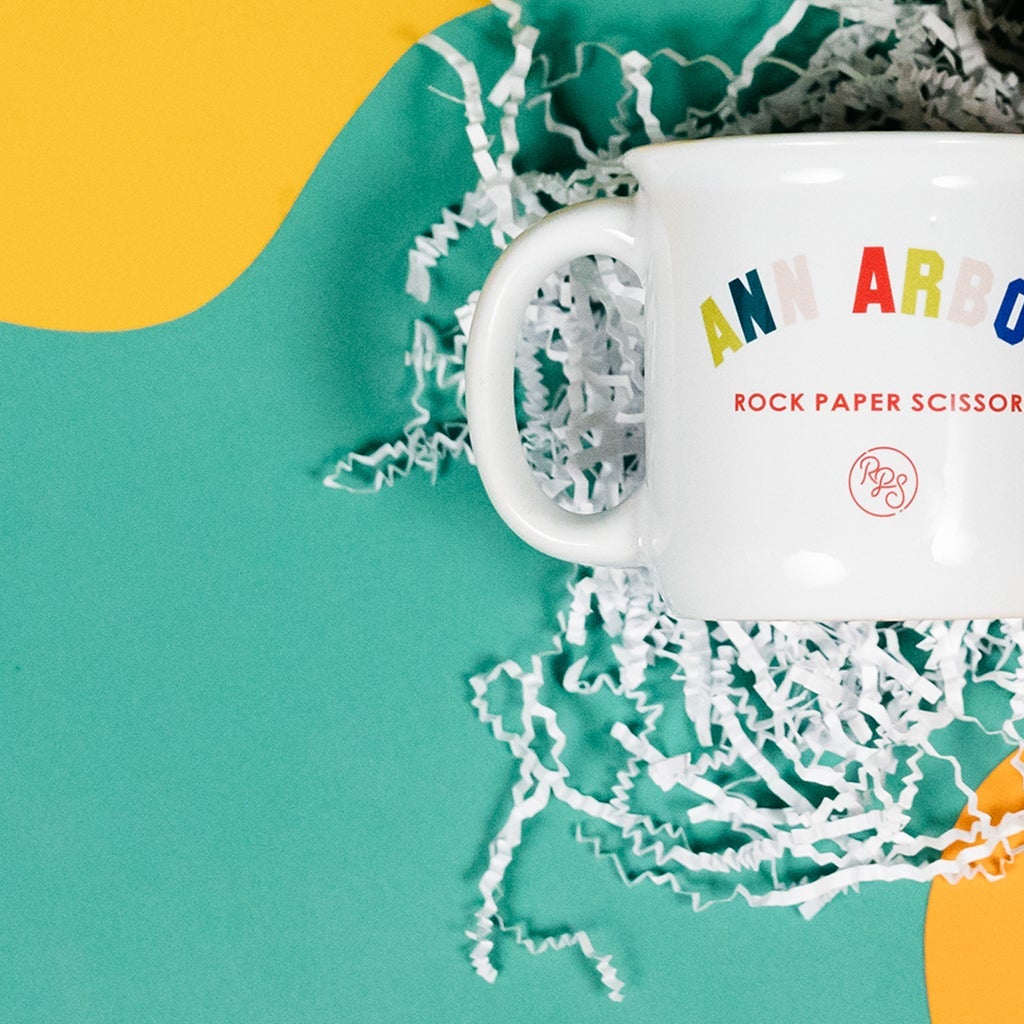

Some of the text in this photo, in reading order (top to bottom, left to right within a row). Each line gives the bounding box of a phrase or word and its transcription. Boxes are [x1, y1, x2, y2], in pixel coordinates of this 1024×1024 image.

[699, 254, 821, 368] ANN
[734, 393, 805, 412] ROCK
[815, 393, 901, 412] PAPER
